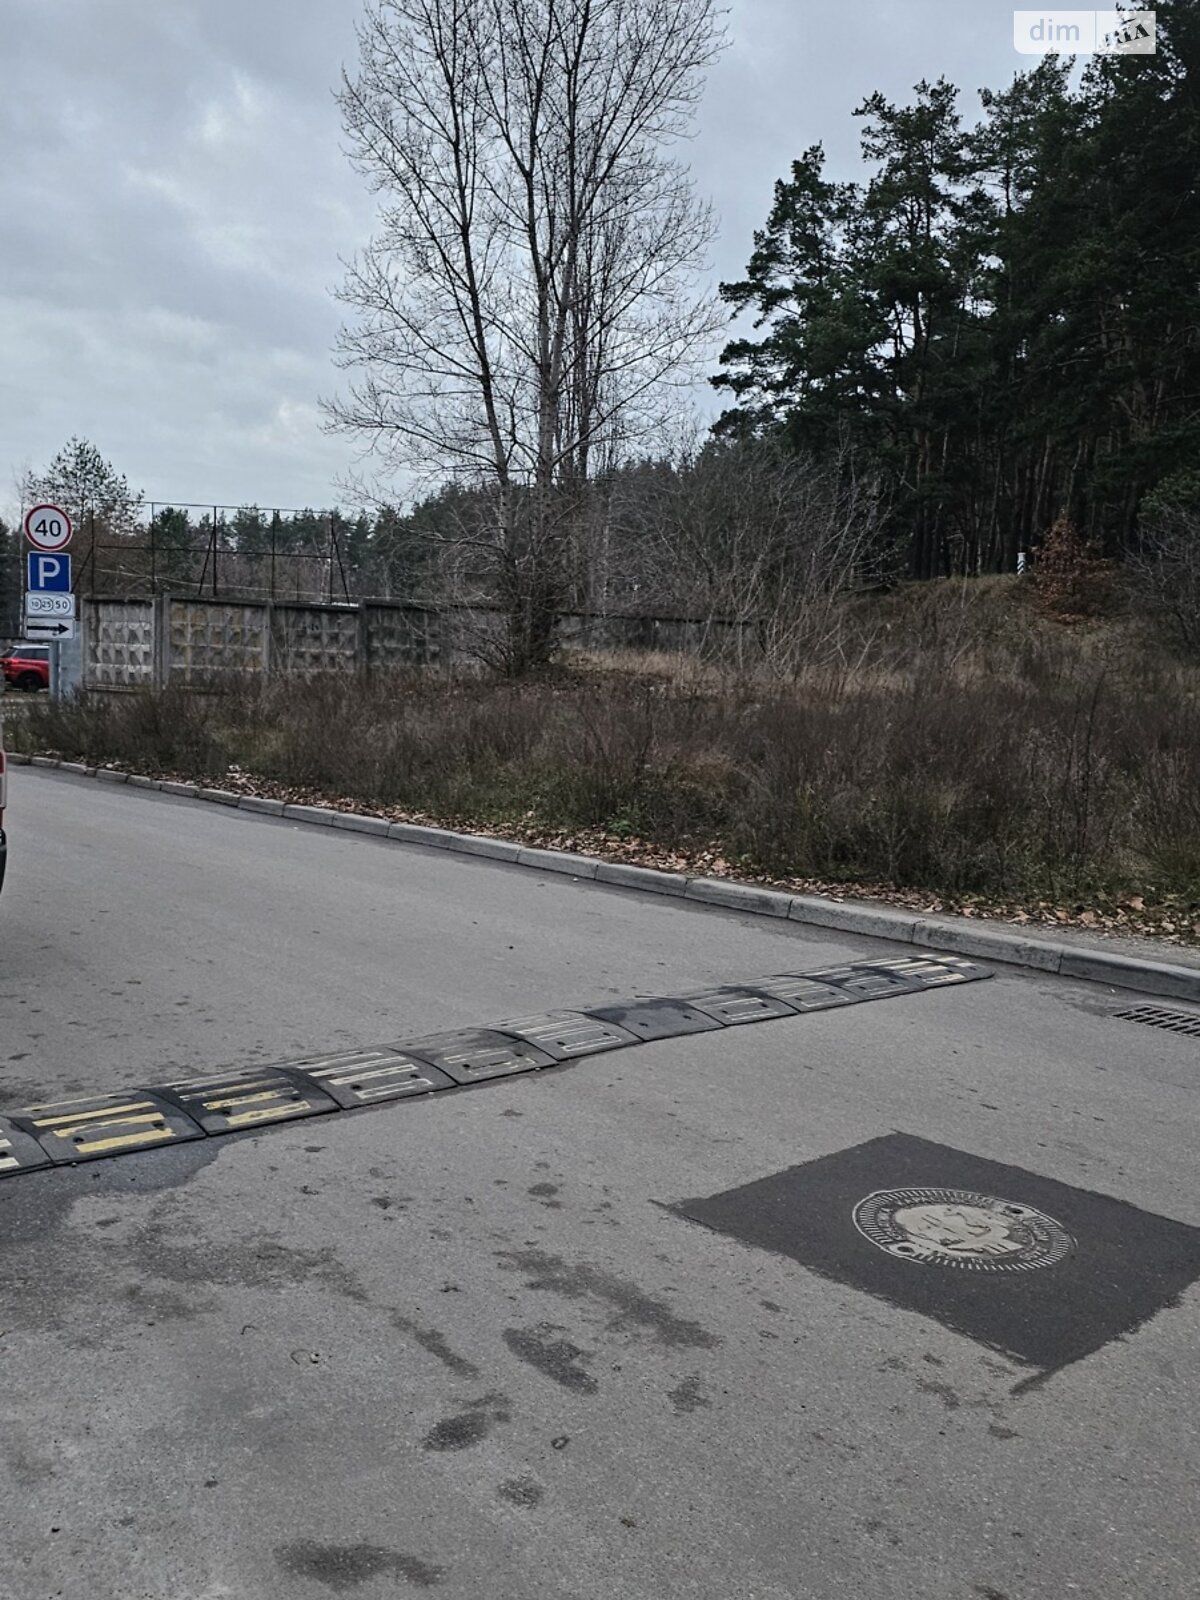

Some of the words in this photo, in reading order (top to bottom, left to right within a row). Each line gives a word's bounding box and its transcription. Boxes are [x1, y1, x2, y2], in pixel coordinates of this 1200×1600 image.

[34, 519, 62, 537] 40
[38, 556, 61, 588] P
[55, 600, 67, 609] 50
